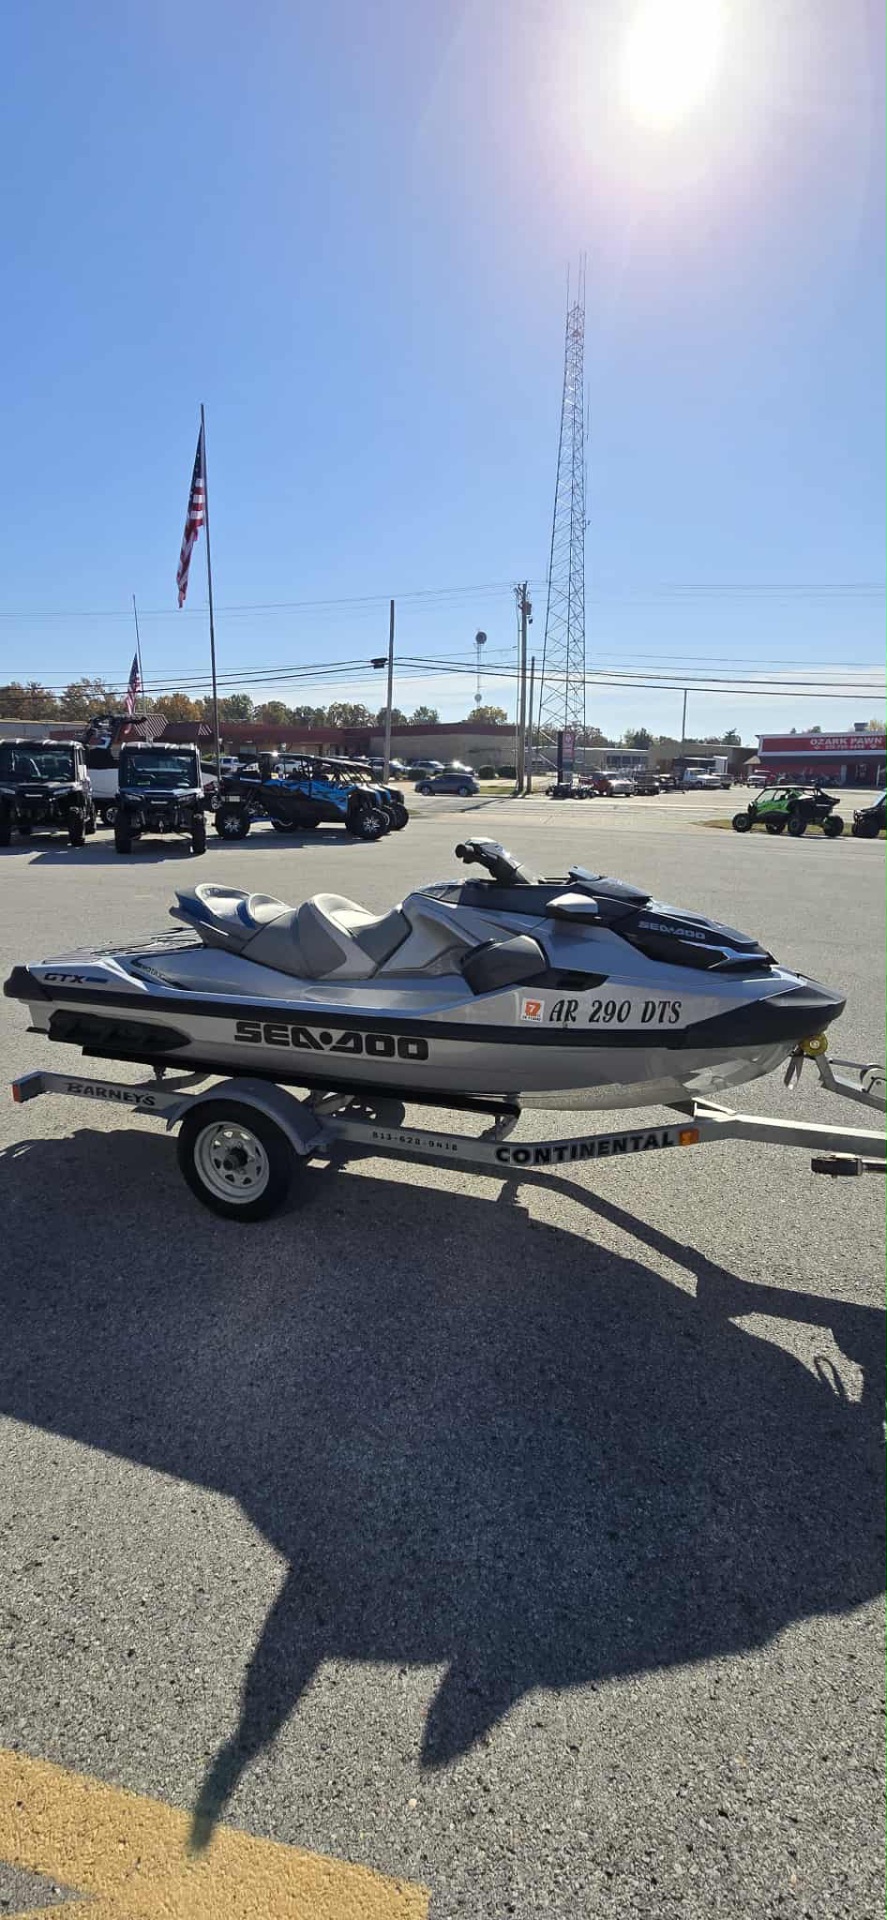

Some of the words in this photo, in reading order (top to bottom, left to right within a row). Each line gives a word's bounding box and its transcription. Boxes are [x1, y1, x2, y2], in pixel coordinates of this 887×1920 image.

[810, 737, 848, 746] OZARK
[850, 736, 883, 745] PAWN
[44, 972, 83, 984] GTX
[549, 999, 579, 1023] AR
[588, 1000, 632, 1023] 290
[640, 1000, 682, 1024] DTS
[495, 1131, 674, 1164] CONTINENTAL
